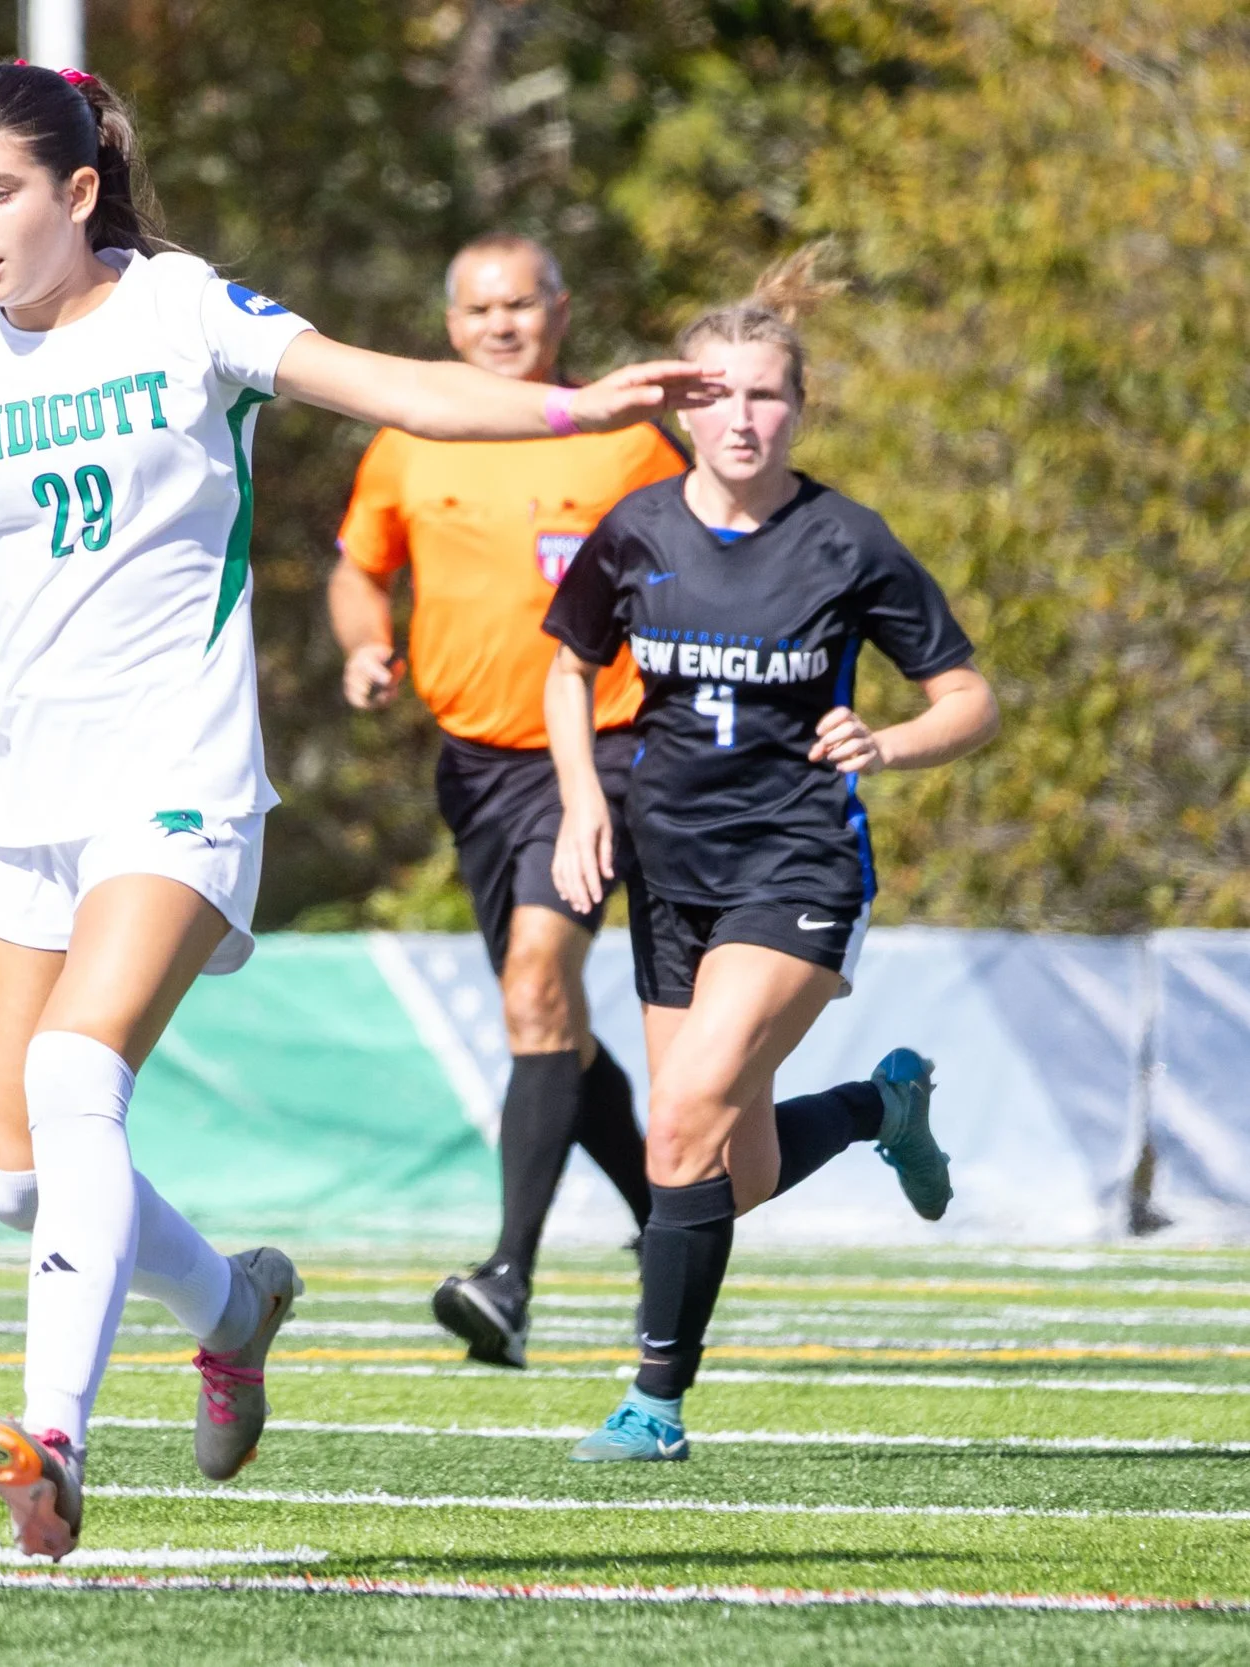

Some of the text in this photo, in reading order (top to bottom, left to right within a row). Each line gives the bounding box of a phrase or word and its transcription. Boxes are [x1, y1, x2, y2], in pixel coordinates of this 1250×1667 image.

[32, 464, 114, 559] 29
[640, 626, 803, 651] UNIVERSITY OF
[678, 643, 830, 684] ENGLAND
[695, 682, 734, 748] 4
